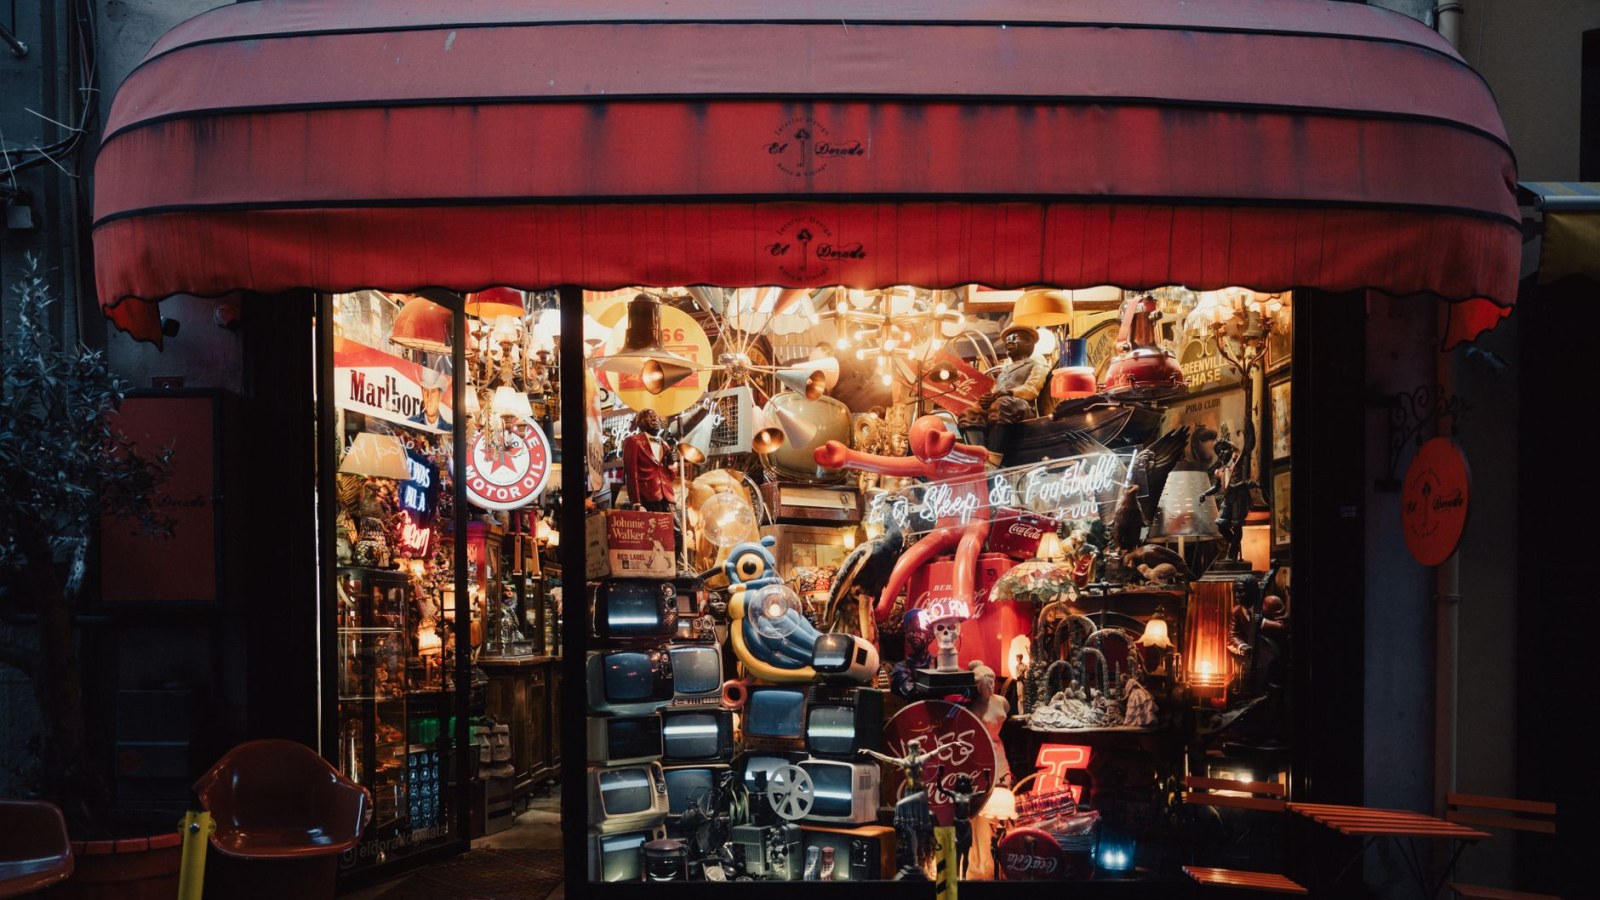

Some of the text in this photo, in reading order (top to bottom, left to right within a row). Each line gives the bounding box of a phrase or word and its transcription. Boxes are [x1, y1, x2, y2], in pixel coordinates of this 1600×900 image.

[814, 140, 864, 158] Dorado
[816, 242, 866, 262] Dorado
[1188, 368, 1221, 388] CHASE
[466, 460, 543, 500] MOTOR OIL
[920, 483, 979, 525] Sleep
[989, 474, 1012, 507] &
[611, 516, 645, 529] Johnnie
[1009, 523, 1043, 540] Coca-Cola
[612, 528, 645, 540] Walker
[1007, 852, 1058, 873] Coca-Cola
